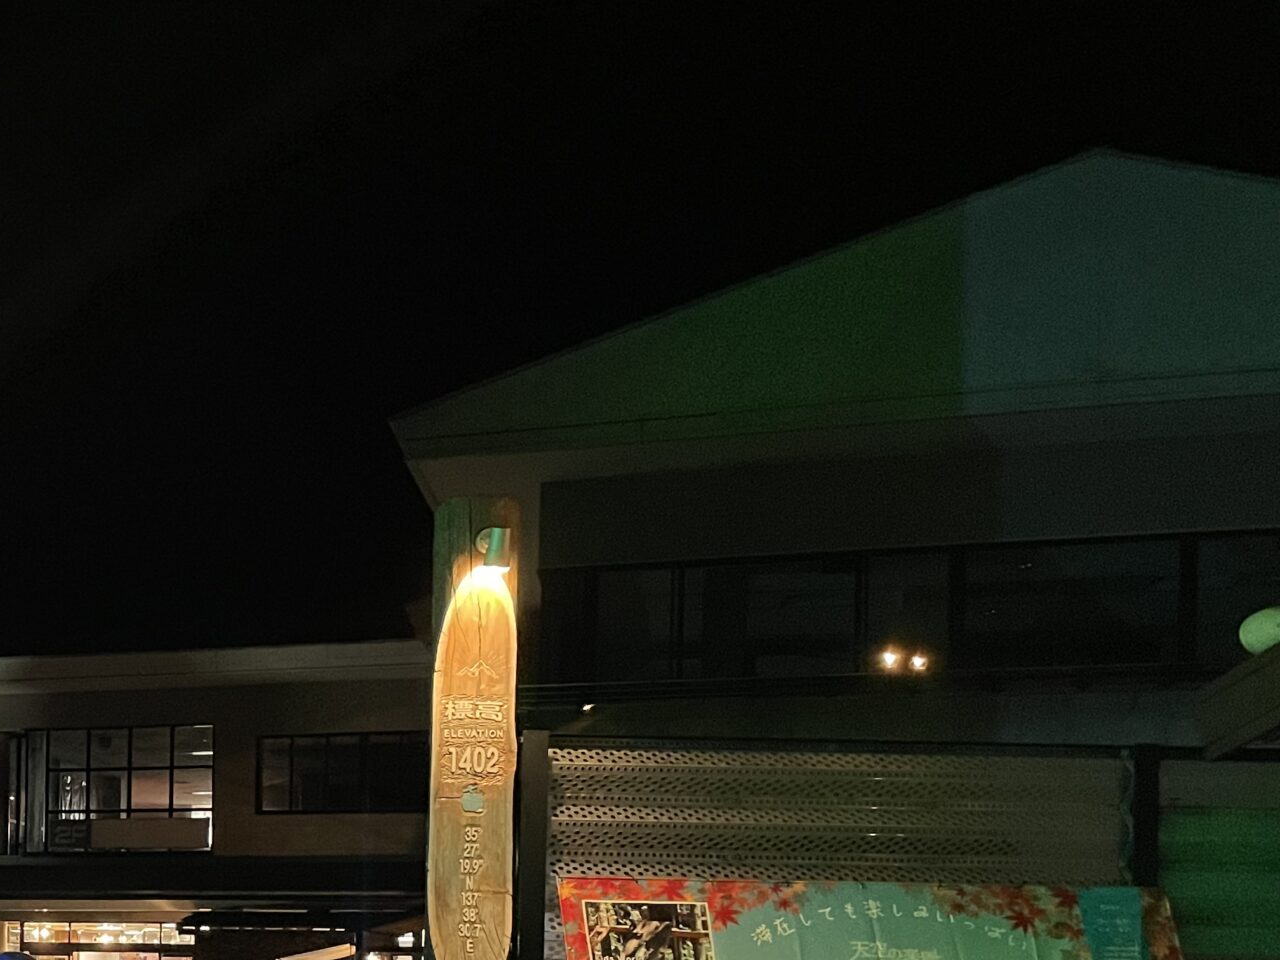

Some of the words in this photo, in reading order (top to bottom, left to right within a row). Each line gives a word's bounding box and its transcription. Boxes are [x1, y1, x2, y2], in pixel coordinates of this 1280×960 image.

[444, 700, 504, 722] 標高
[443, 728, 505, 738] ELEVATION
[448, 746, 500, 774] 1402
[465, 875, 475, 890] N
[466, 939, 475, 953] E
